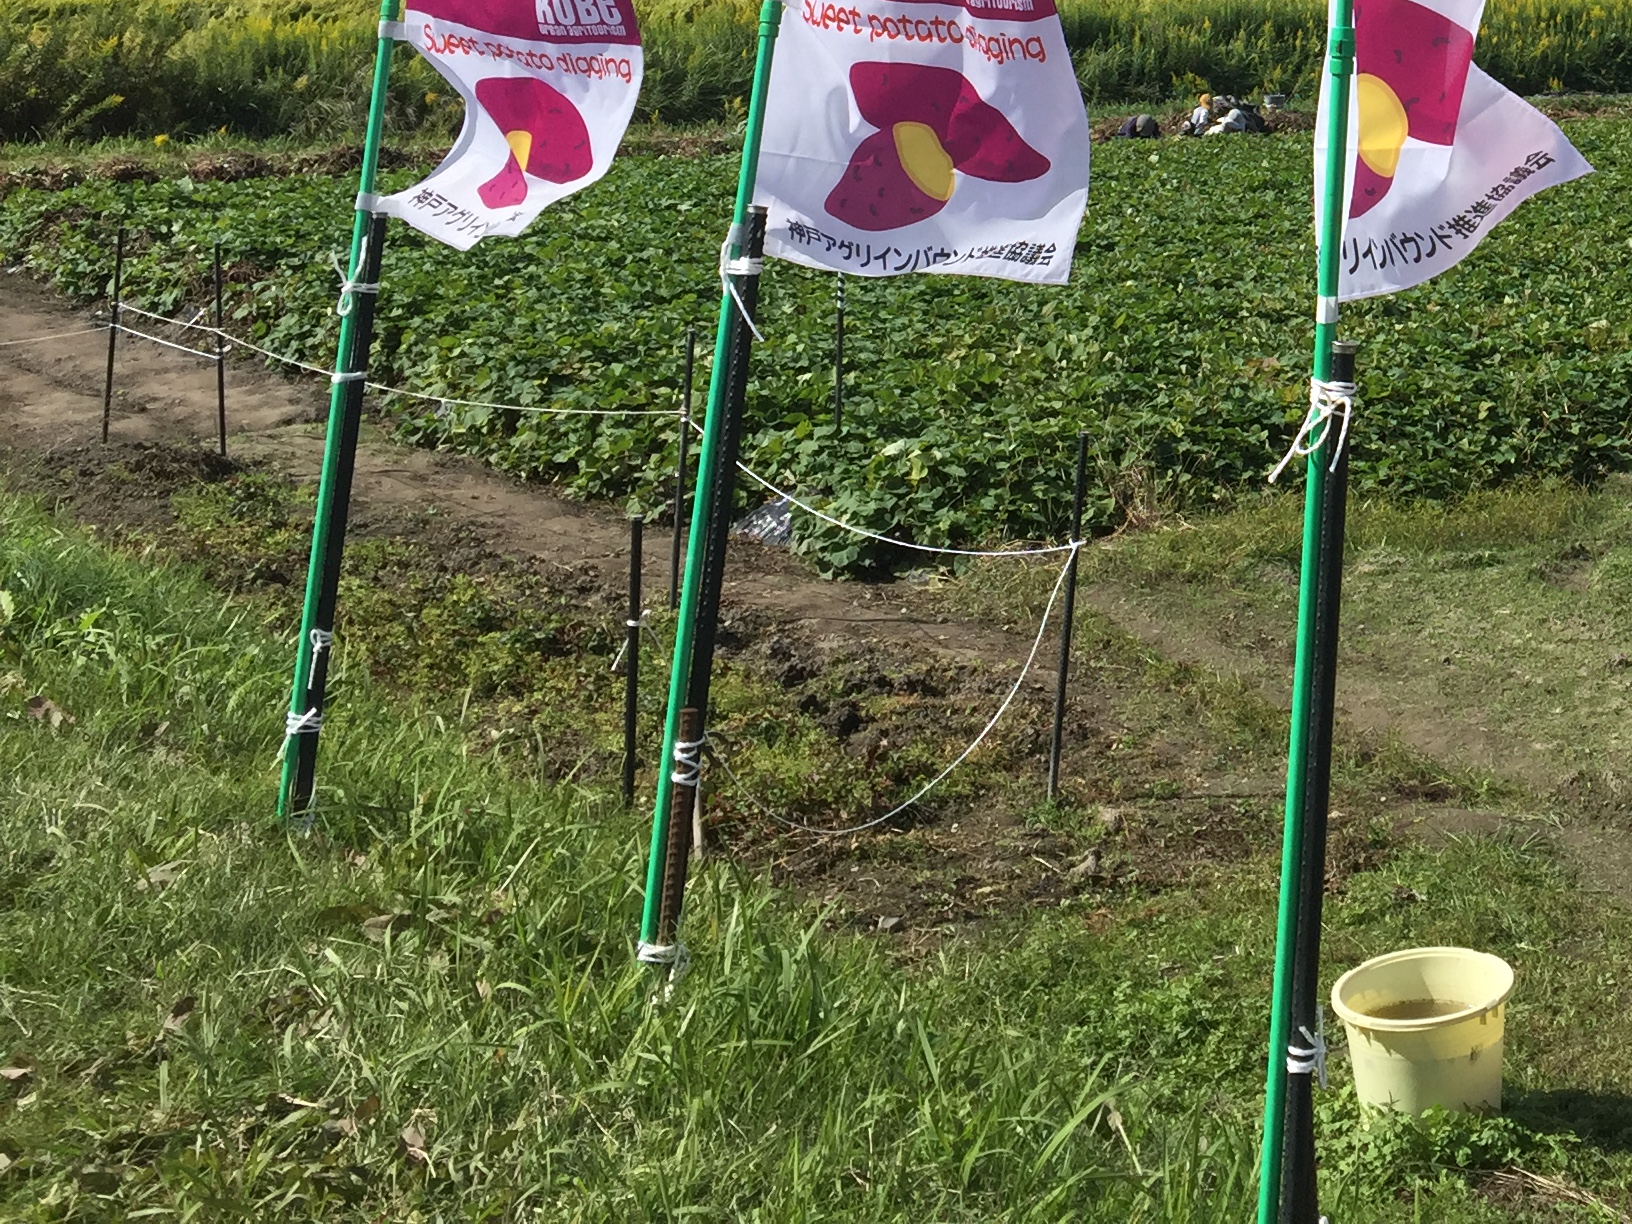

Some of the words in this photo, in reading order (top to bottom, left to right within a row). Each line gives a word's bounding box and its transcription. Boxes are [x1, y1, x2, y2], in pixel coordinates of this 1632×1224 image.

[867, 14, 965, 44] potato
[423, 23, 486, 57] Sweet
[556, 52, 632, 84] digging
